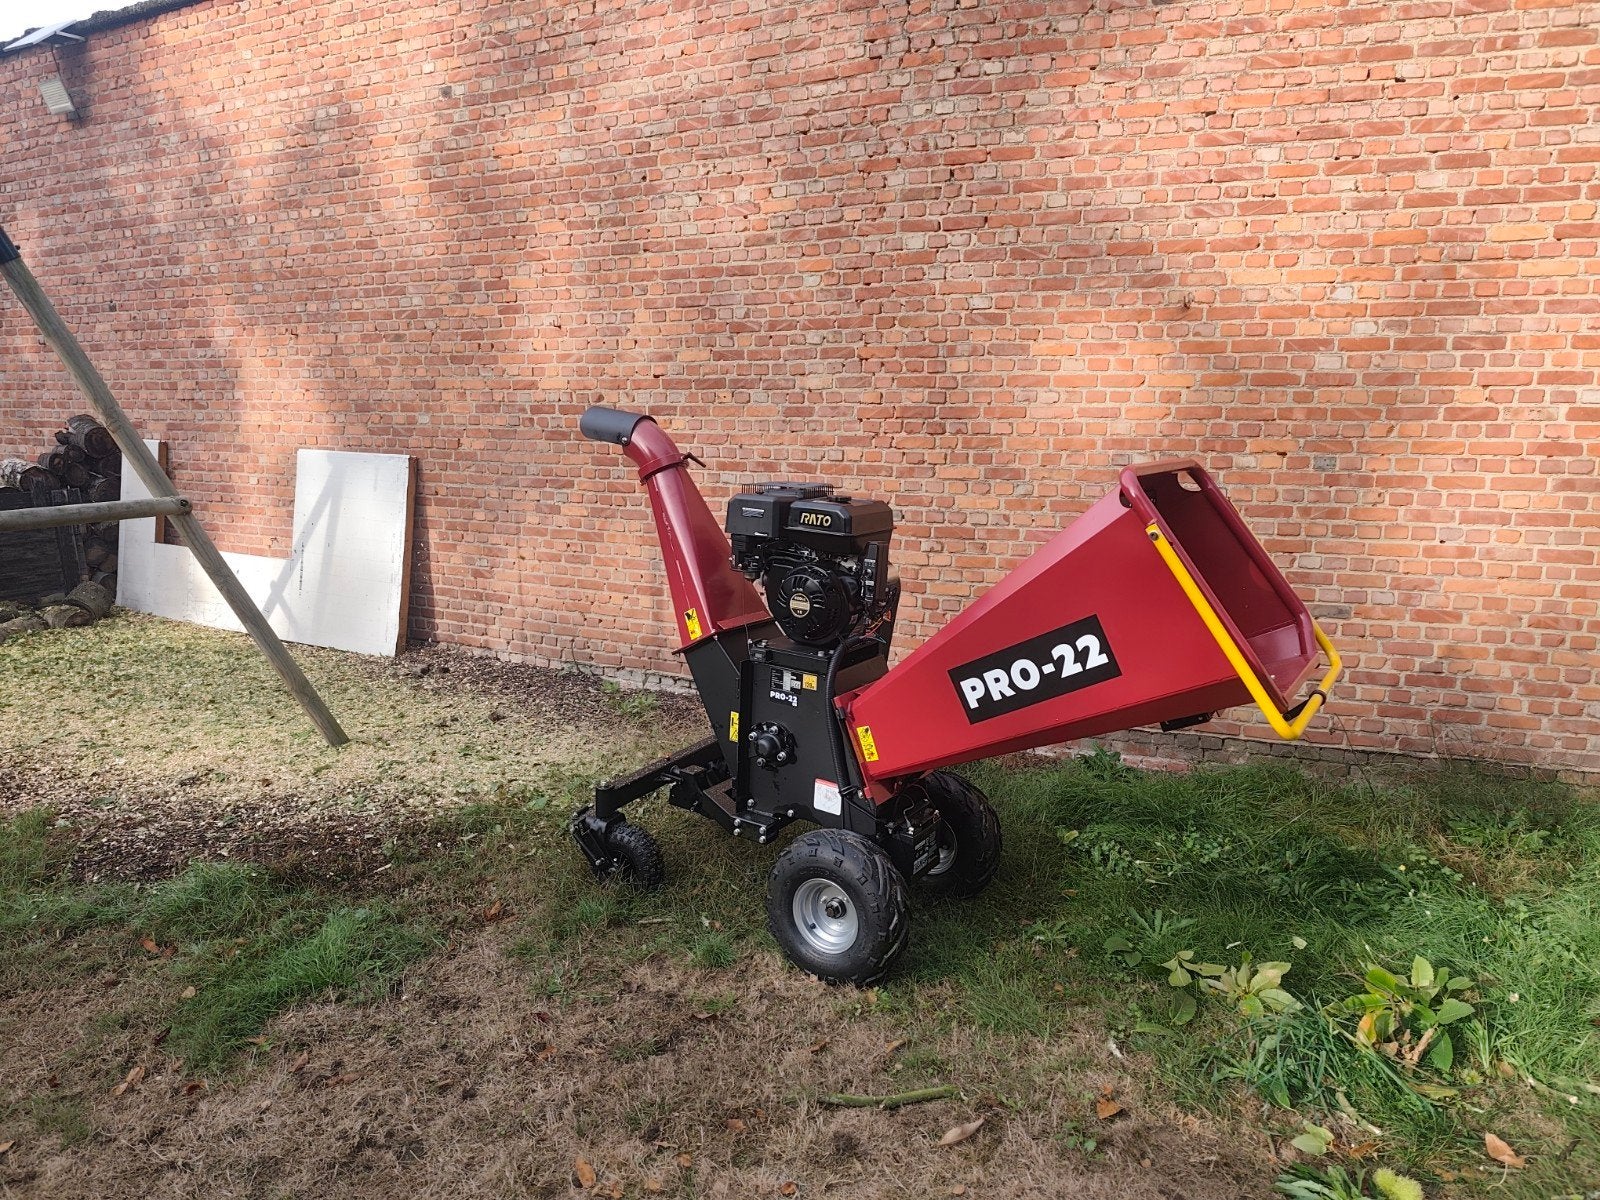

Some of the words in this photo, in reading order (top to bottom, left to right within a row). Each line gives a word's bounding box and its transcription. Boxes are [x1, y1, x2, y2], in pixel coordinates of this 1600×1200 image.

[800, 512, 832, 527] RATO
[959, 634, 1109, 709] PRO-22
[770, 690, 798, 703] PRO-22
